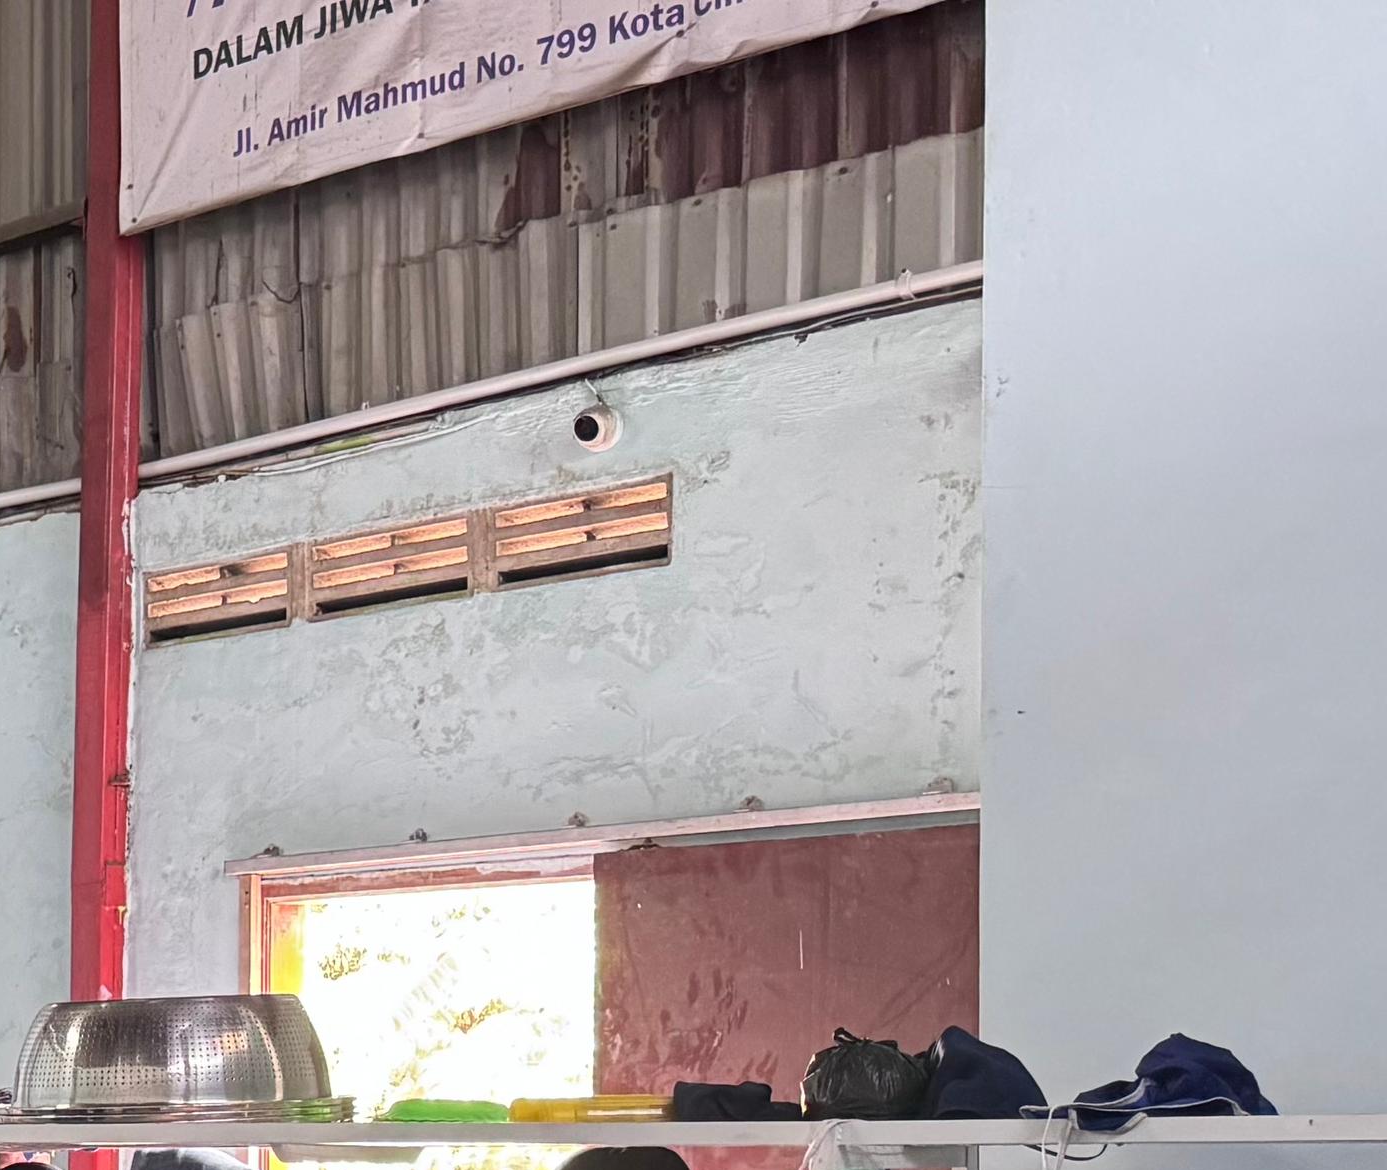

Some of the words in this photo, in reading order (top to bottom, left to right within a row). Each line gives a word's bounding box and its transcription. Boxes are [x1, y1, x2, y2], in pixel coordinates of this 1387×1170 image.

[193, 15, 304, 80] DALAM
[314, 0, 394, 39] JIWA
[233, 127, 259, 157] Jl.
[267, 104, 328, 146] Amir
[337, 61, 466, 123] Mahmud
[476, 51, 525, 84] No.
[536, 22, 597, 65] 799
[608, 3, 685, 45] Kota
